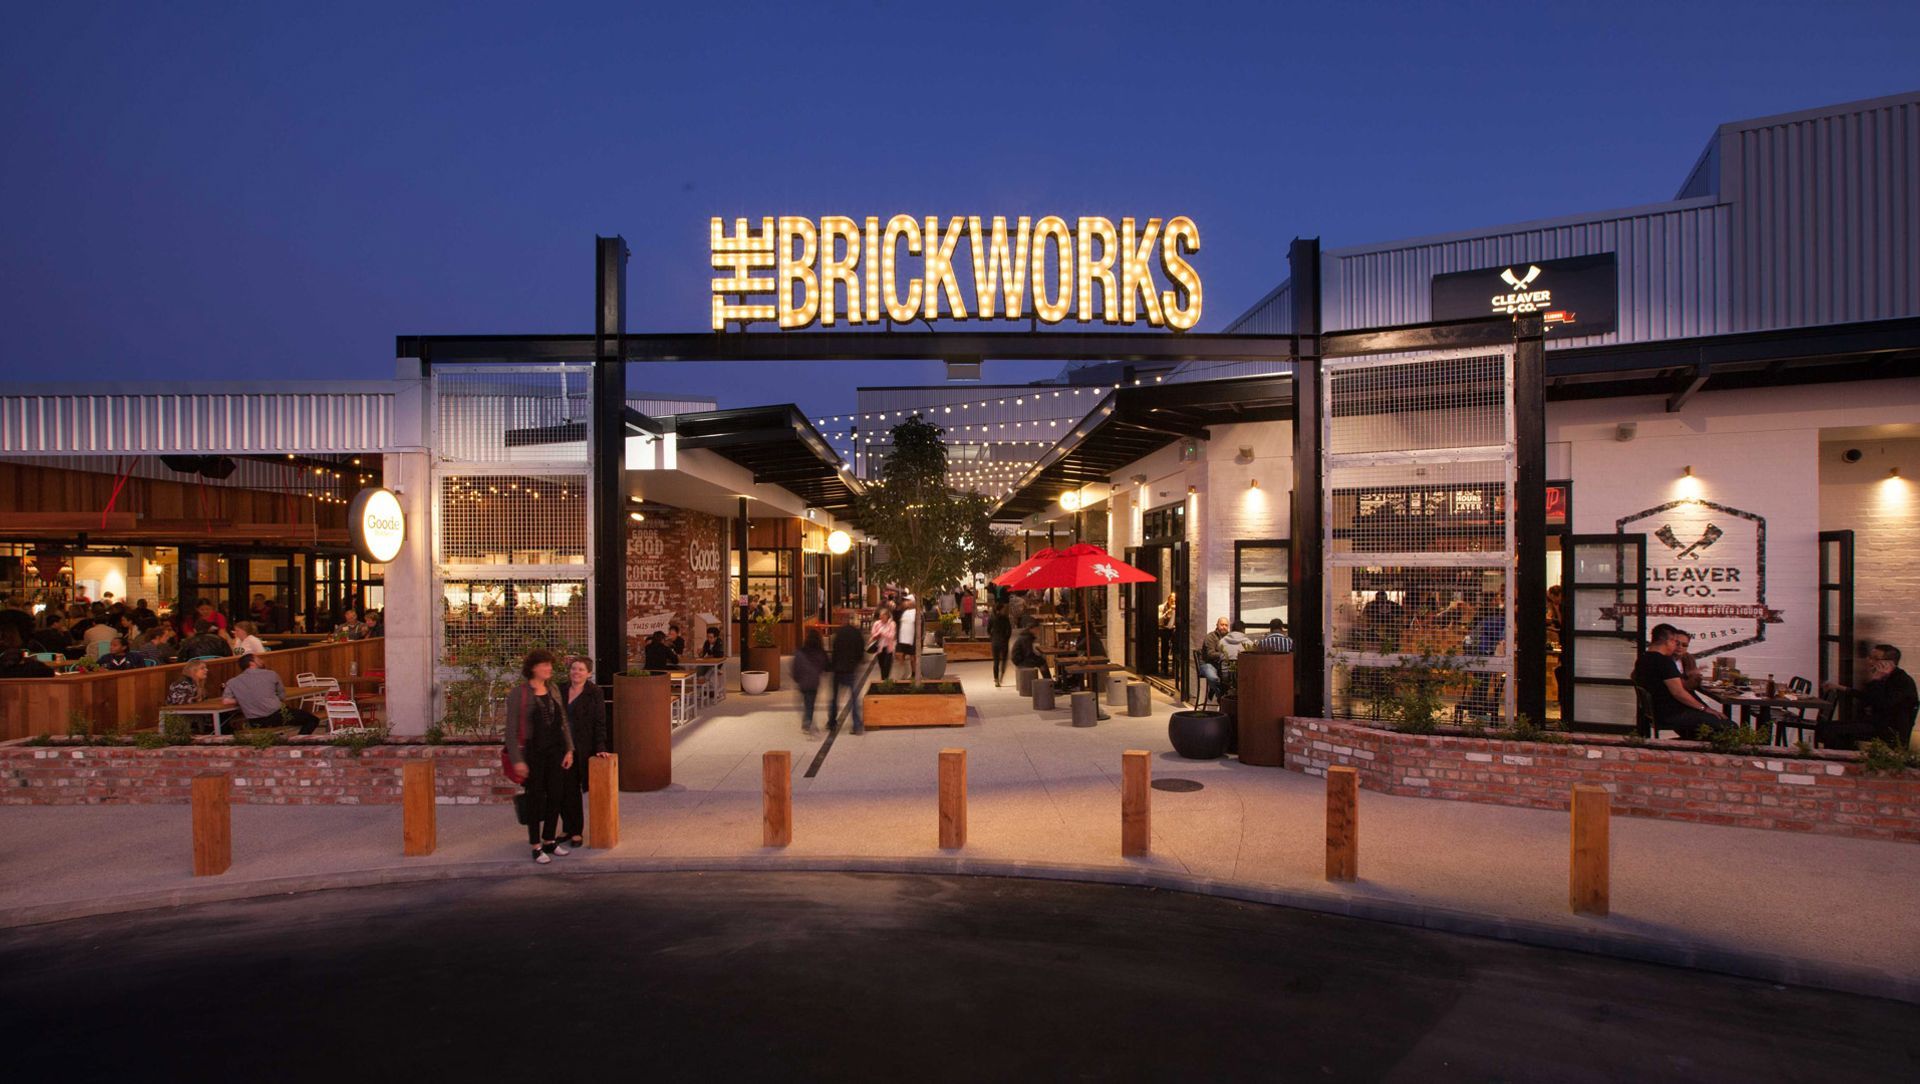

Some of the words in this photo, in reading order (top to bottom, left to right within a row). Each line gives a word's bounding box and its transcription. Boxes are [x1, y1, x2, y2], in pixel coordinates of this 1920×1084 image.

[711, 216, 776, 331] THE
[778, 213, 1203, 331] BRICKWORKS
[1491, 290, 1551, 306] CLEAVER
[1506, 305, 1517, 314] &
[1517, 302, 1537, 313] CO.
[368, 515, 400, 529] Goode
[626, 539, 664, 556] FOOD
[689, 538, 720, 571] Goode
[626, 564, 665, 581] COFFEE
[626, 590, 666, 606] PIZZA
[1665, 585, 1680, 597] &
[1683, 585, 1716, 597] CO.
[1658, 606, 1677, 614] MEAT
